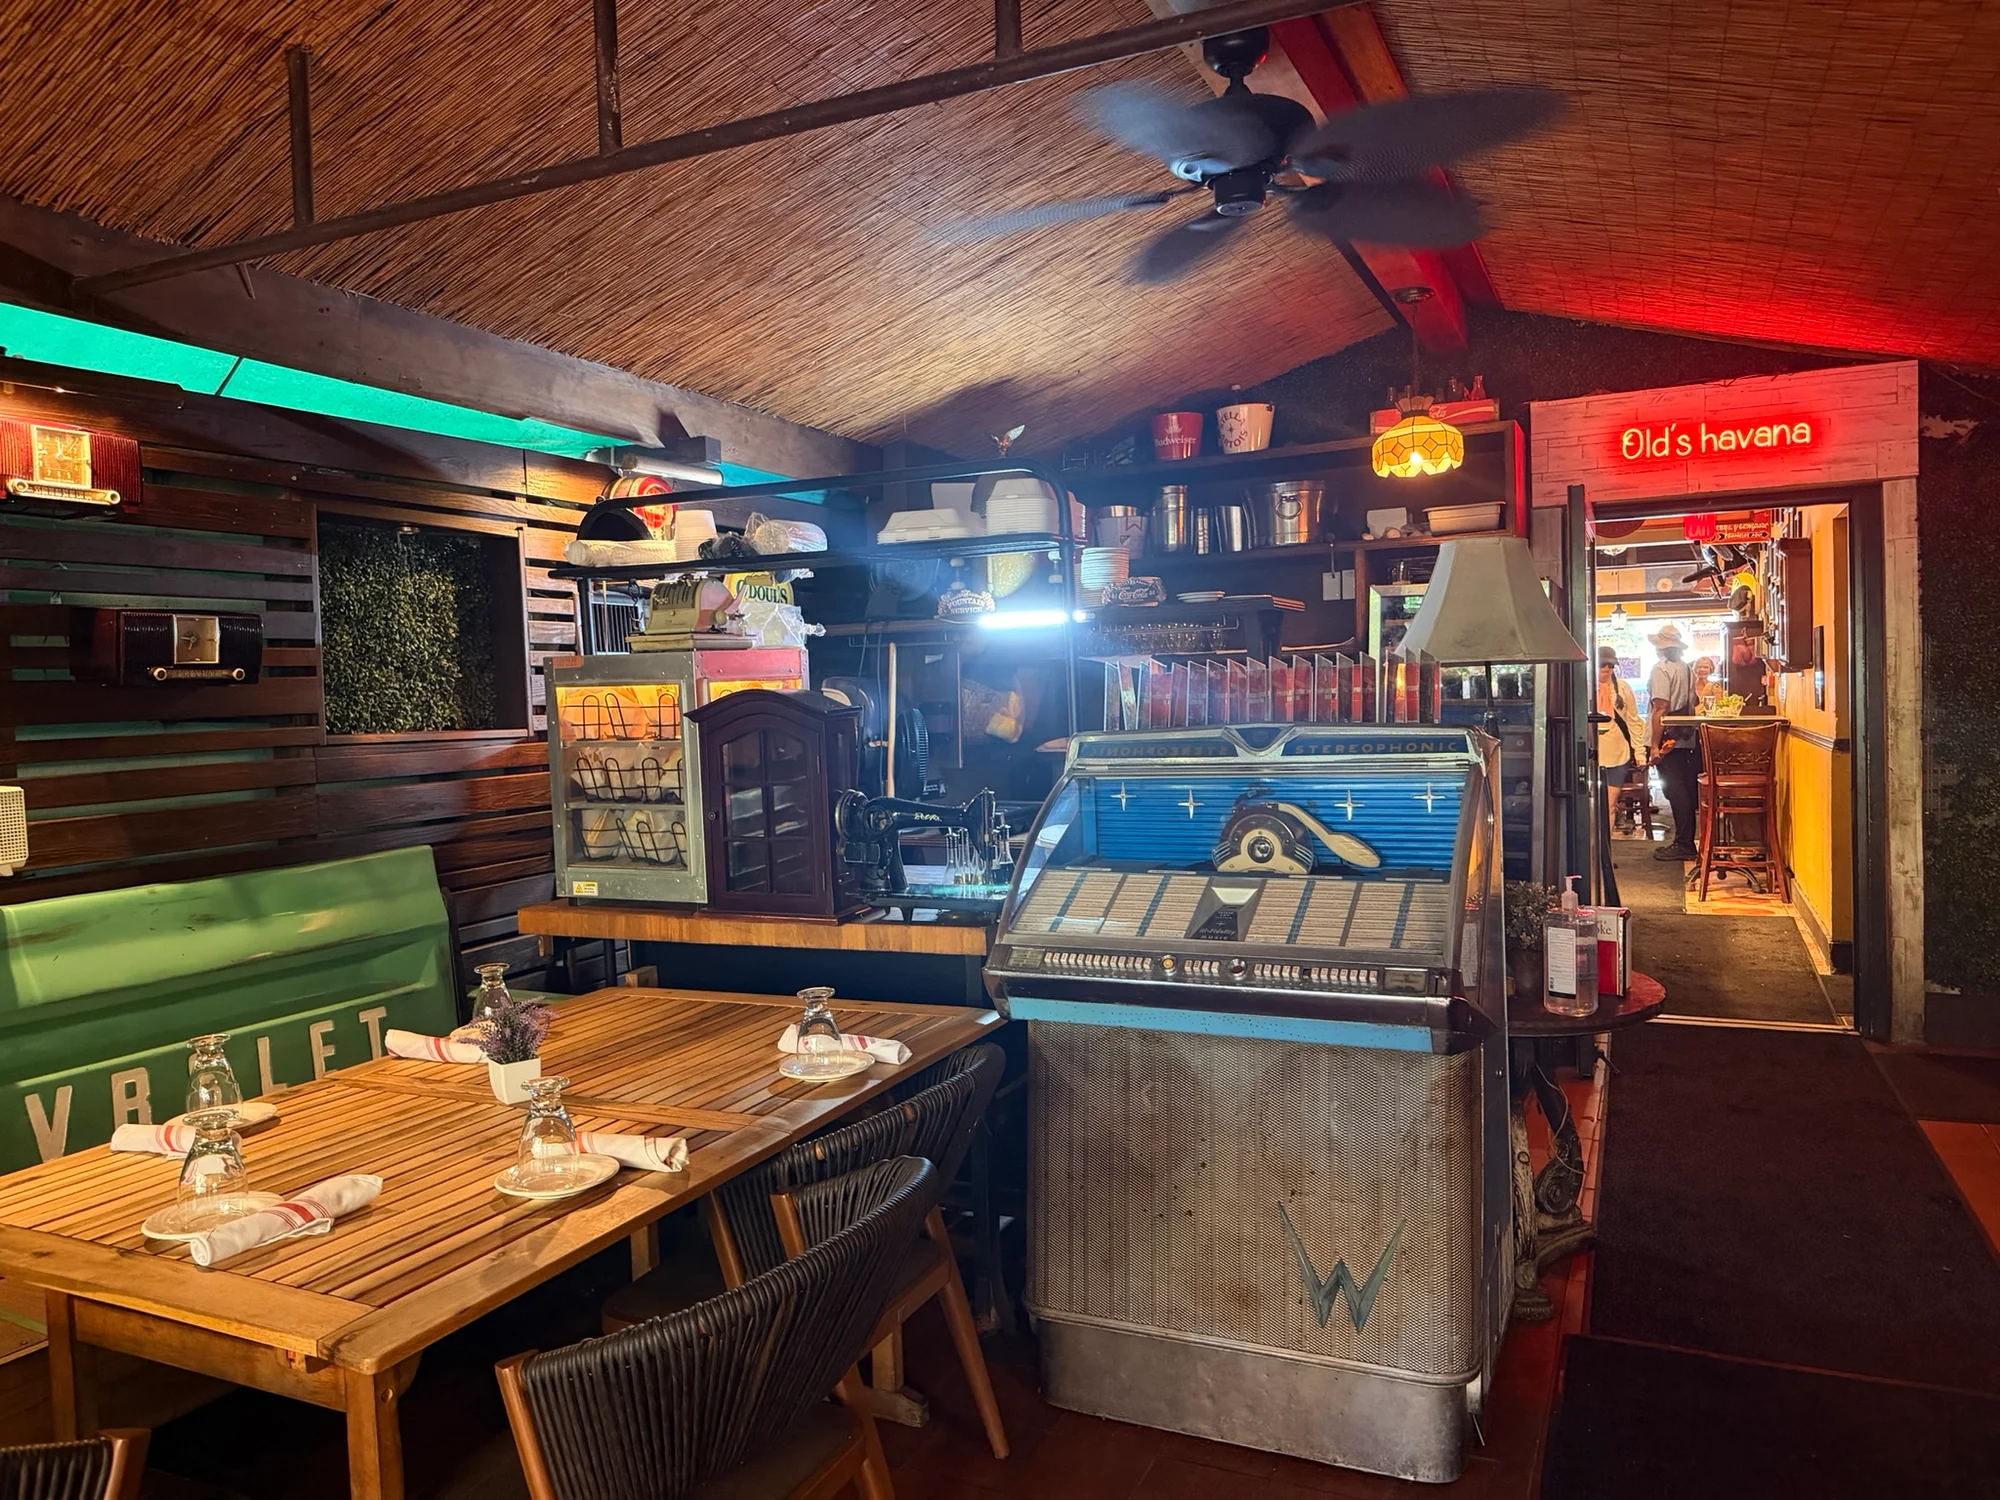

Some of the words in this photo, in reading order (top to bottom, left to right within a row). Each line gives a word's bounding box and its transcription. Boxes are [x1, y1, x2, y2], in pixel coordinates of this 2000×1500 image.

[1153, 435, 1197, 448] Budweiser
[1621, 422, 1693, 460] Old's
[1702, 422, 1810, 453] havana
[736, 579, 788, 604] ODOUL'S
[946, 597, 986, 609] FOUNTAIN
[950, 607, 983, 615] SERVICE
[1295, 741, 1457, 755] STEREOPHONIC
